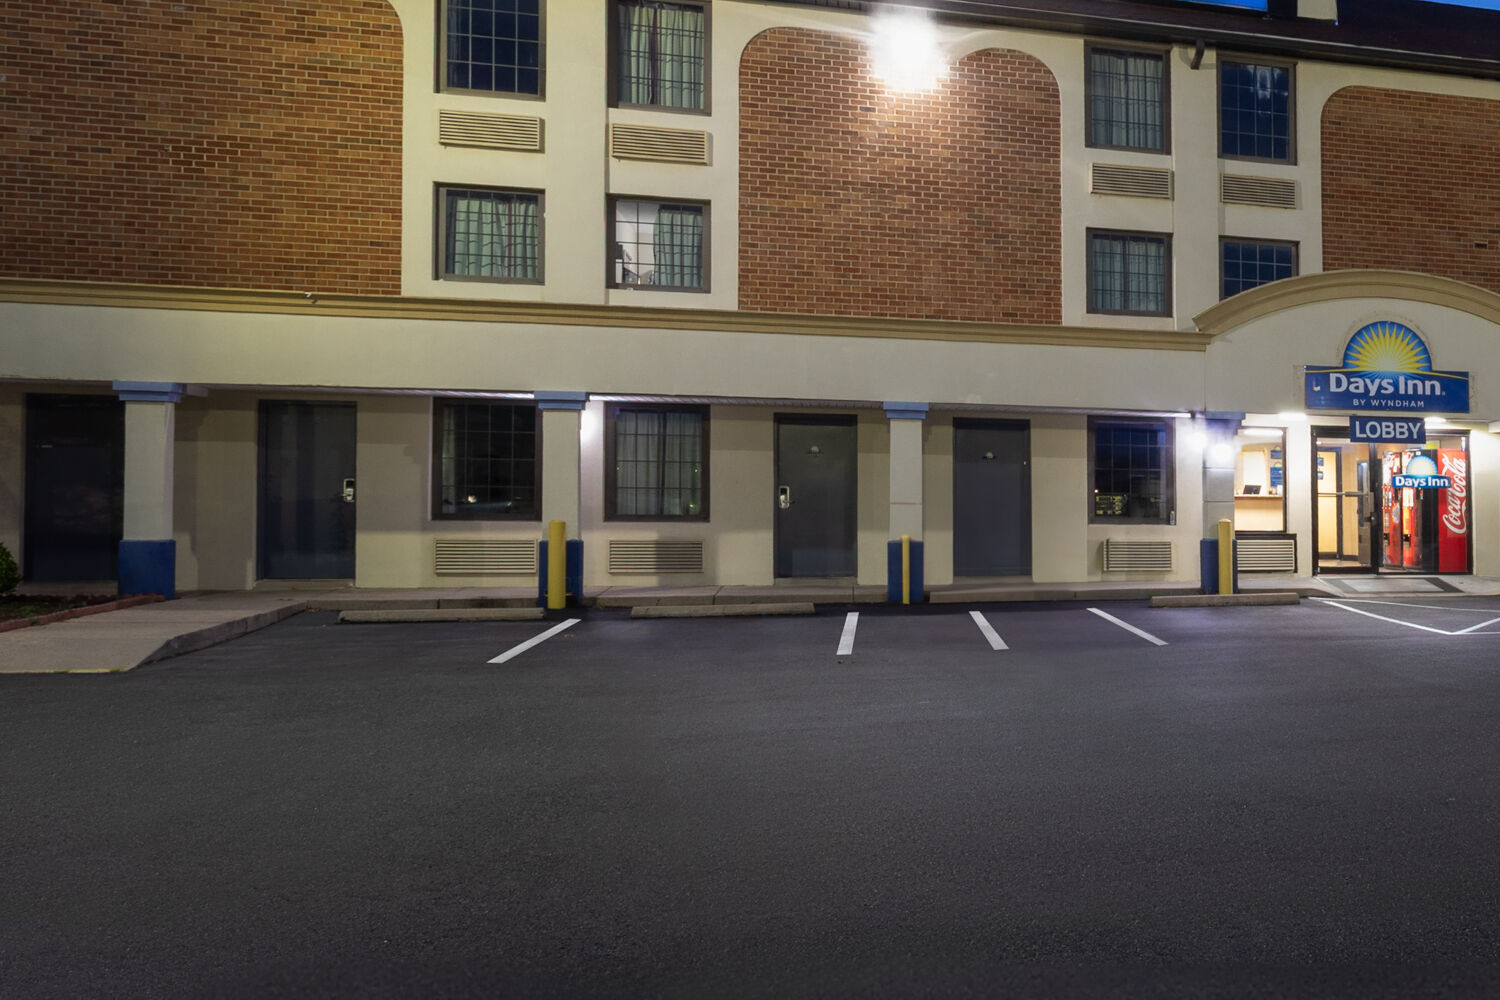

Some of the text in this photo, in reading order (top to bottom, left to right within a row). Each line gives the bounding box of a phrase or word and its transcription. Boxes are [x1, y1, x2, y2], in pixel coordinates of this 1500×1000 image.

[1329, 373, 1441, 396] Days Inn
[1352, 398, 1425, 408] BY WYNDHAM
[1355, 420, 1421, 439] LOBBY
[1395, 476, 1425, 487] Days
